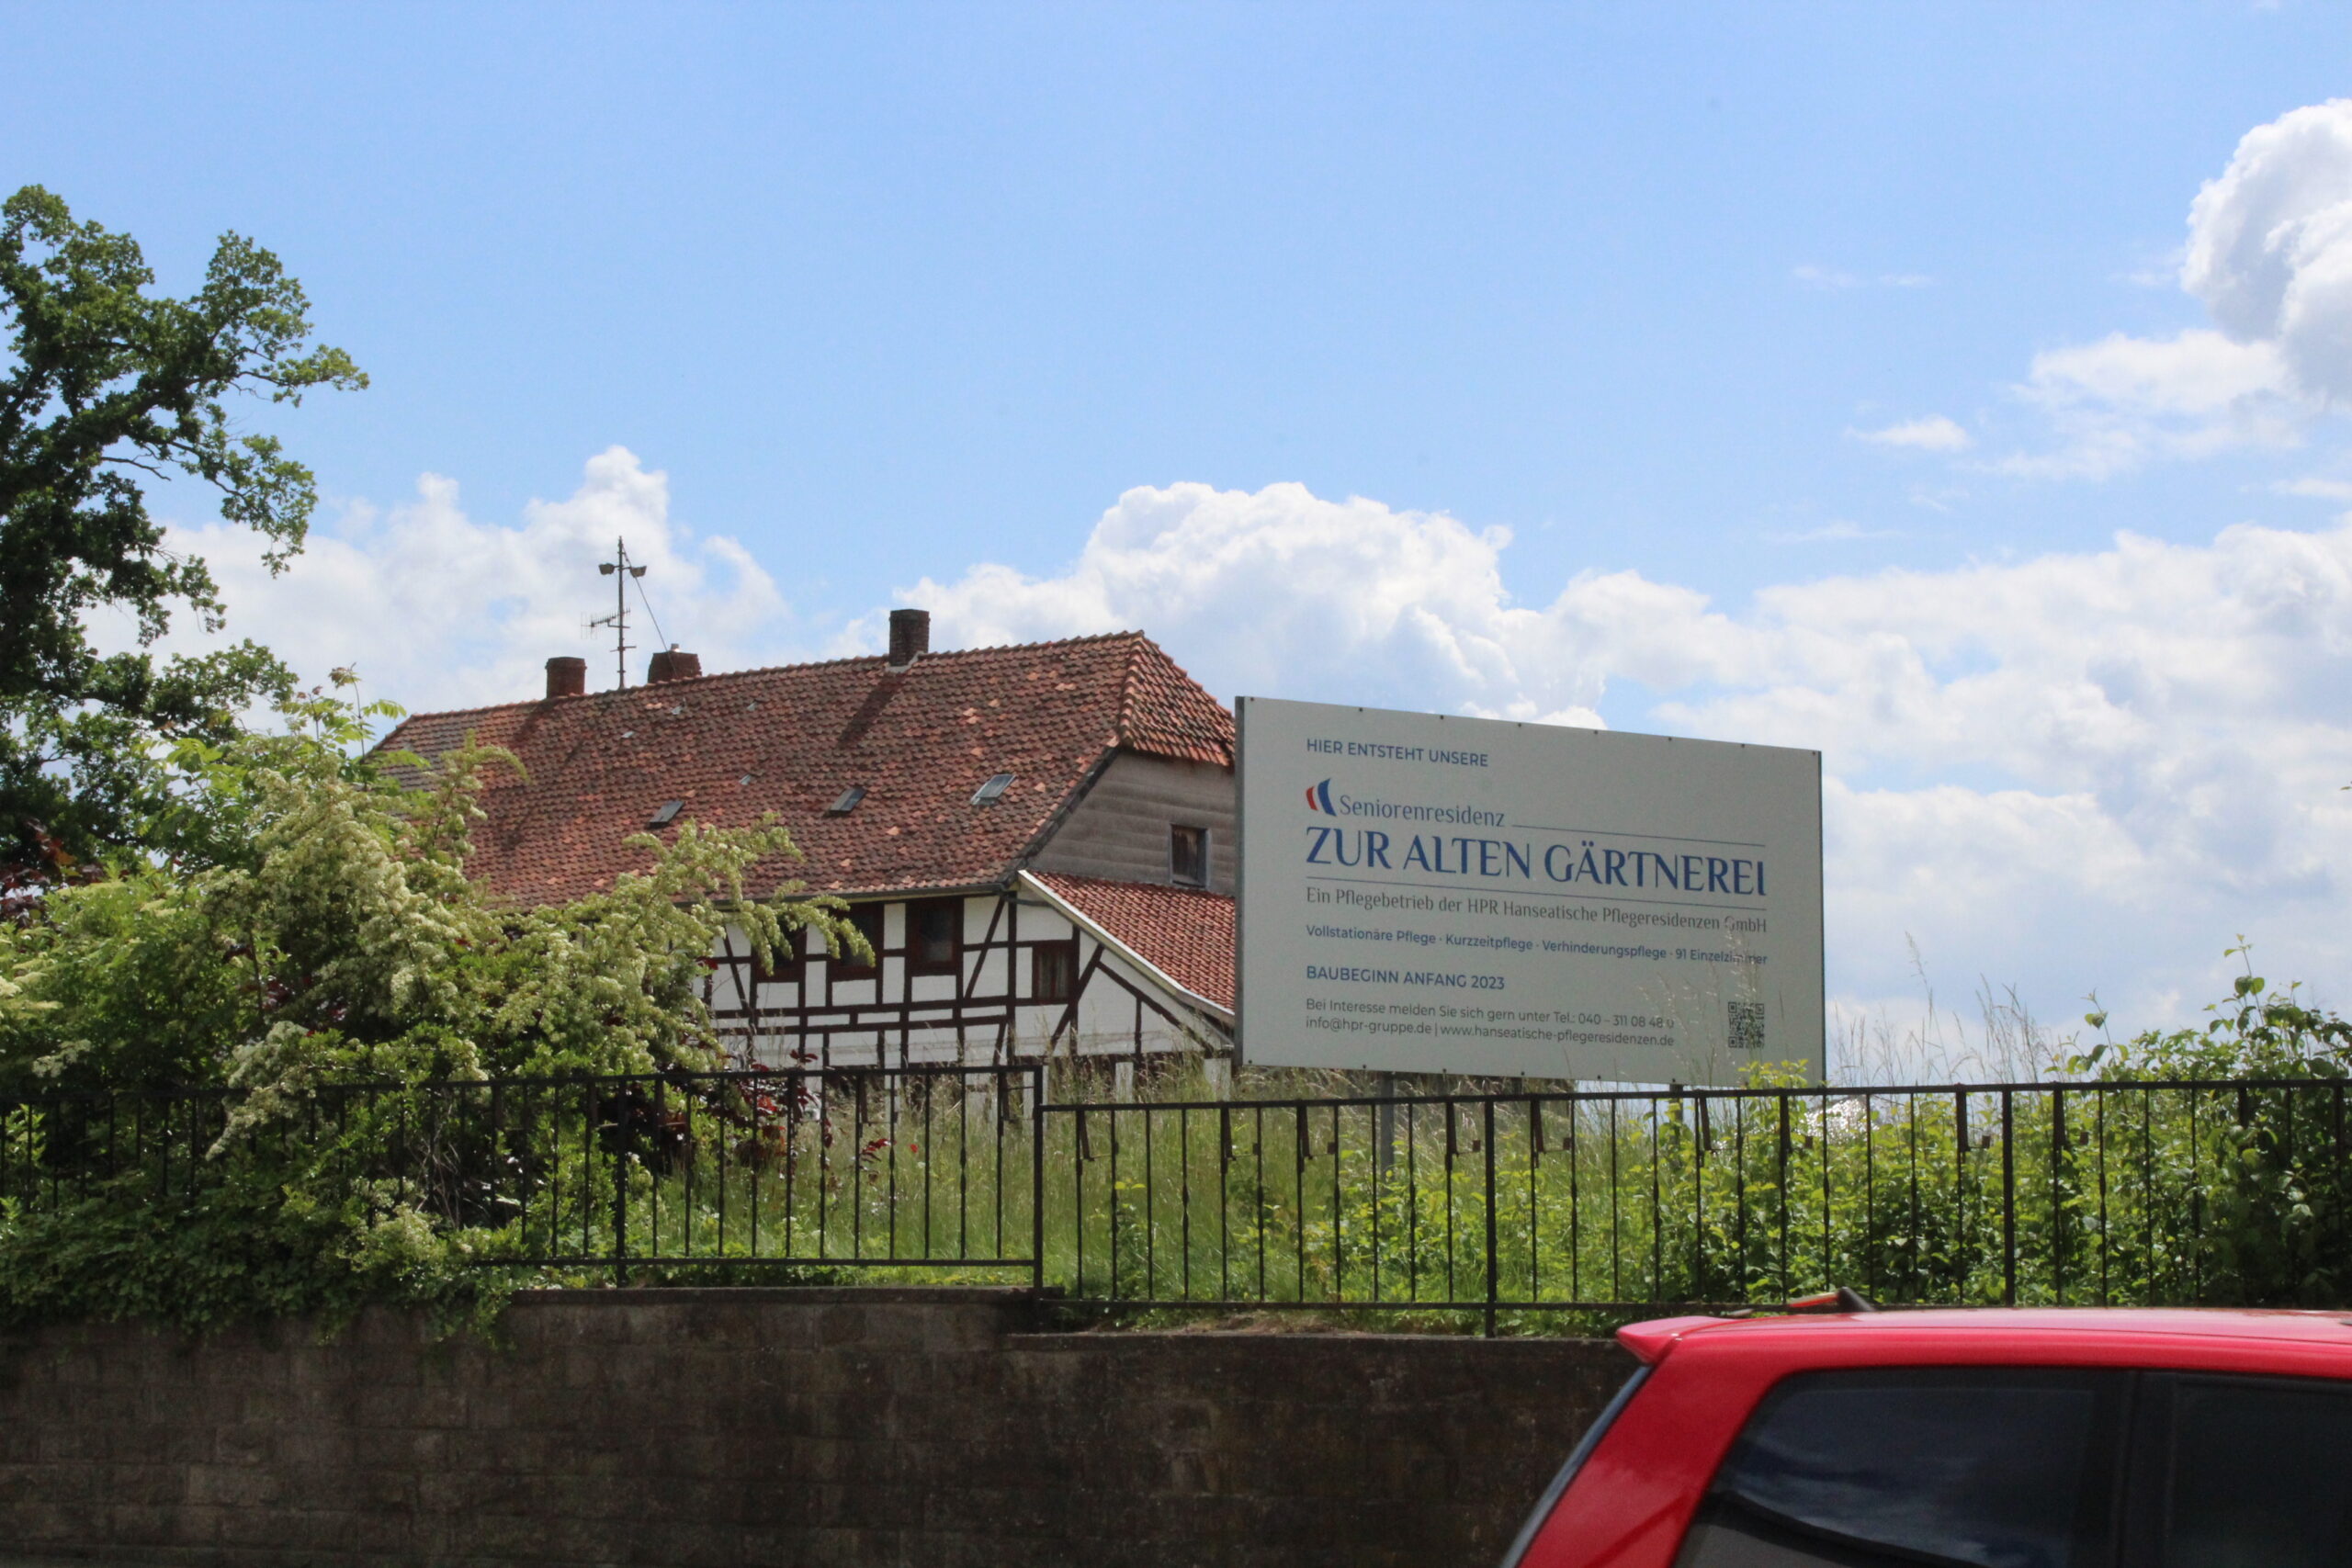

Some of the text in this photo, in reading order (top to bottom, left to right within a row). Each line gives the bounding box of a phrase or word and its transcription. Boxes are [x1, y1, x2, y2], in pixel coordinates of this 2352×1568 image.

[1306, 739, 1488, 767] HIER ENTSTEHT UNSERE
[1340, 795, 1505, 827] Seniorenresidenz
[1306, 826, 1767, 897] ZUR ALTEN GÄRTNEREI
[1306, 886, 1330, 904] Ein
[1336, 889, 1434, 911] Pflegebetrieb
[1439, 896, 1463, 912] der
[1468, 898, 1498, 916] HPR
[1503, 901, 1598, 922] Hanseatische
[1603, 908, 1720, 930] Pflegeresidenzen
[1306, 924, 1393, 942] Vollstationäre
[1396, 930, 1436, 946] Pflege
[1446, 933, 1533, 952] Kurzzeitpflege
[1543, 940, 1667, 961] Verhinderungspflege
[1676, 948, 1687, 960] 91
[1306, 965, 1505, 989] BAUBEGINN ANFANG 2023
[1306, 998, 1326, 1011] Bei
[1329, 999, 1385, 1014] Interesse
[1389, 1003, 1436, 1017] melden
[1439, 1005, 1457, 1018] Sie
[1460, 1006, 1483, 1020] sich
[1487, 1010, 1515, 1022] gern
[1518, 1011, 1550, 1021] unter
[1578, 1013, 1601, 1025] 040
[1612, 1014, 1628, 1027] 311
[1631, 1015, 1645, 1028] 08
[1648, 1016, 1663, 1029] 48
[1306, 1016, 1432, 1036] info@hpr-gruppe.de
[1440, 1023, 1675, 1046] www.hanseatische-pflegeresidenzen.de
